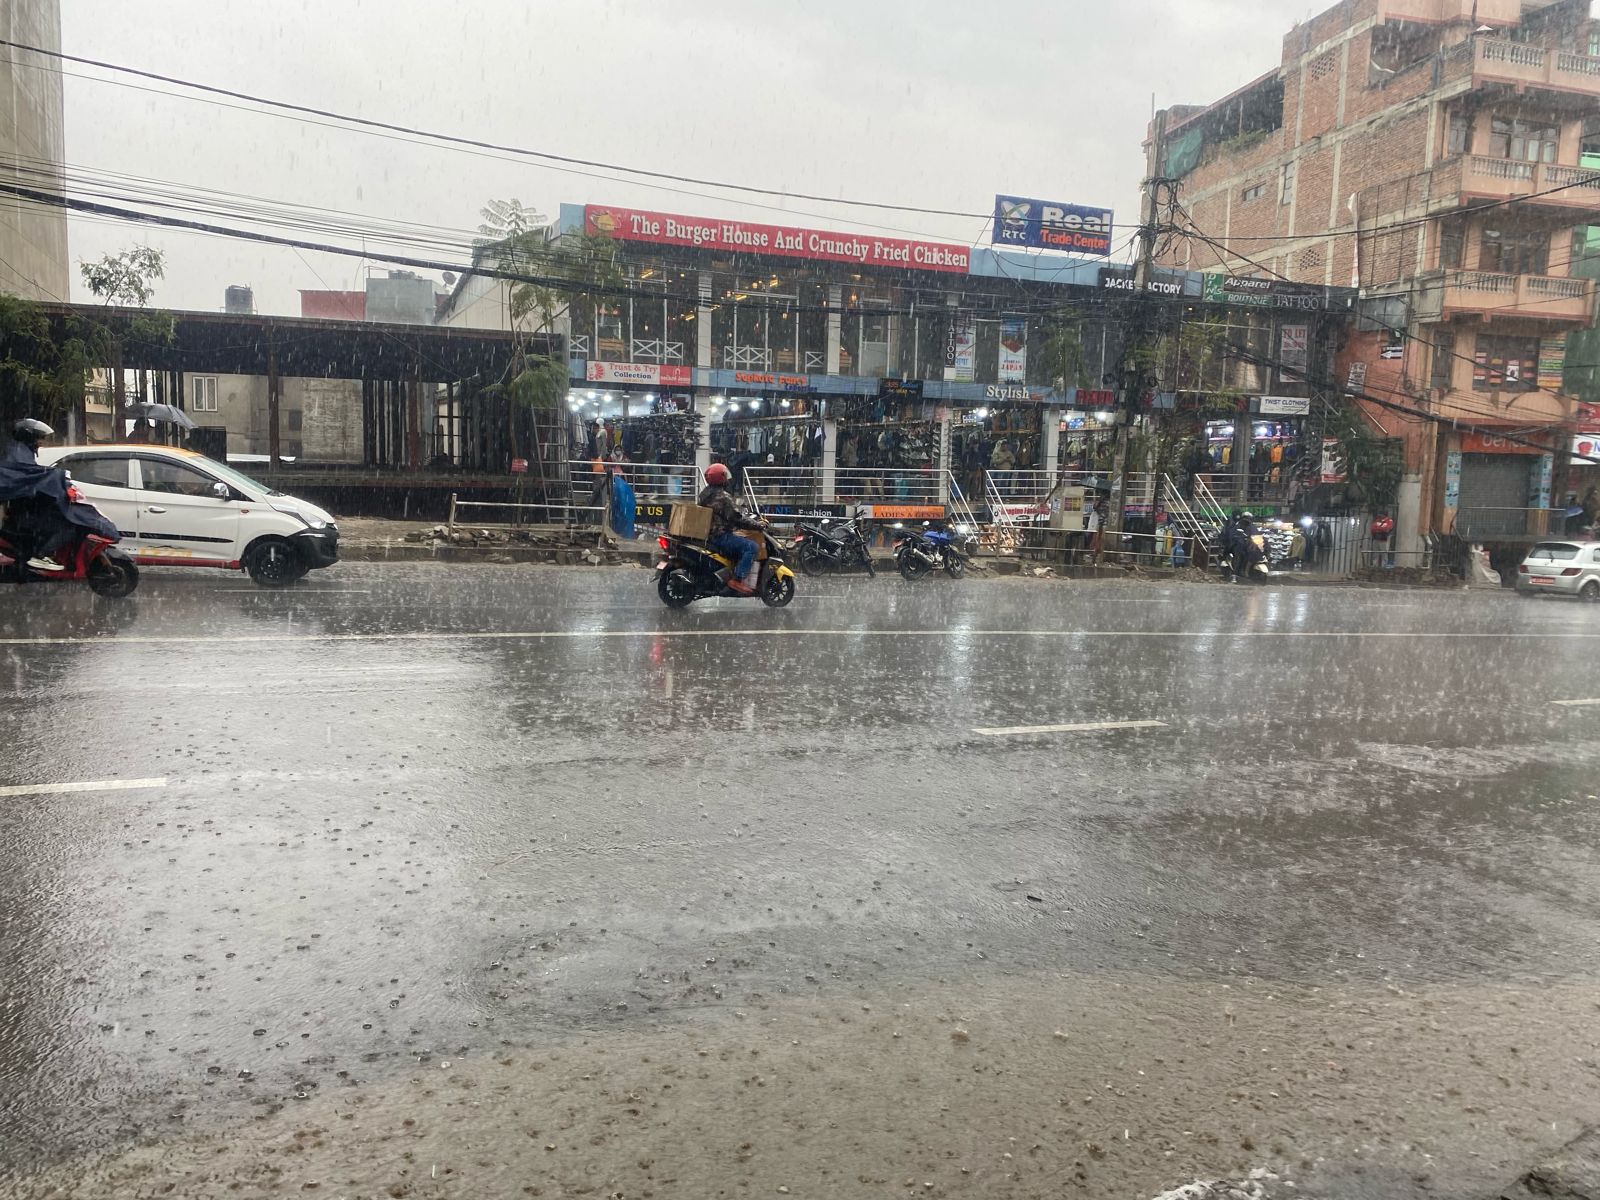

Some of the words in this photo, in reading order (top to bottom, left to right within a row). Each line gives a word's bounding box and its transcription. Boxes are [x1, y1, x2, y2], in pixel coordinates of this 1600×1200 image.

[1042, 206, 1111, 232] Real
[630, 214, 660, 235] The
[665, 219, 718, 245] Burger
[723, 224, 768, 247] House
[774, 230, 803, 250] And
[808, 234, 869, 262] Crunchy
[873, 241, 909, 262] Fried
[914, 246, 967, 267] Chicken
[1002, 230, 1026, 240] RTC
[1040, 229, 1071, 245] Trade
[1073, 233, 1110, 249] Center
[1105, 278, 1136, 290] JACKE
[1147, 282, 1182, 294] ACTORY
[1225, 277, 1271, 289] Apparel
[1227, 294, 1268, 305] BOUTIQUE
[1273, 295, 1319, 310] TATTOO
[609, 363, 633, 371] Trust
[643, 365, 658, 375] Try
[613, 371, 652, 379] Collection
[986, 384, 1030, 401] Stylish
[647, 506, 664, 516] US
